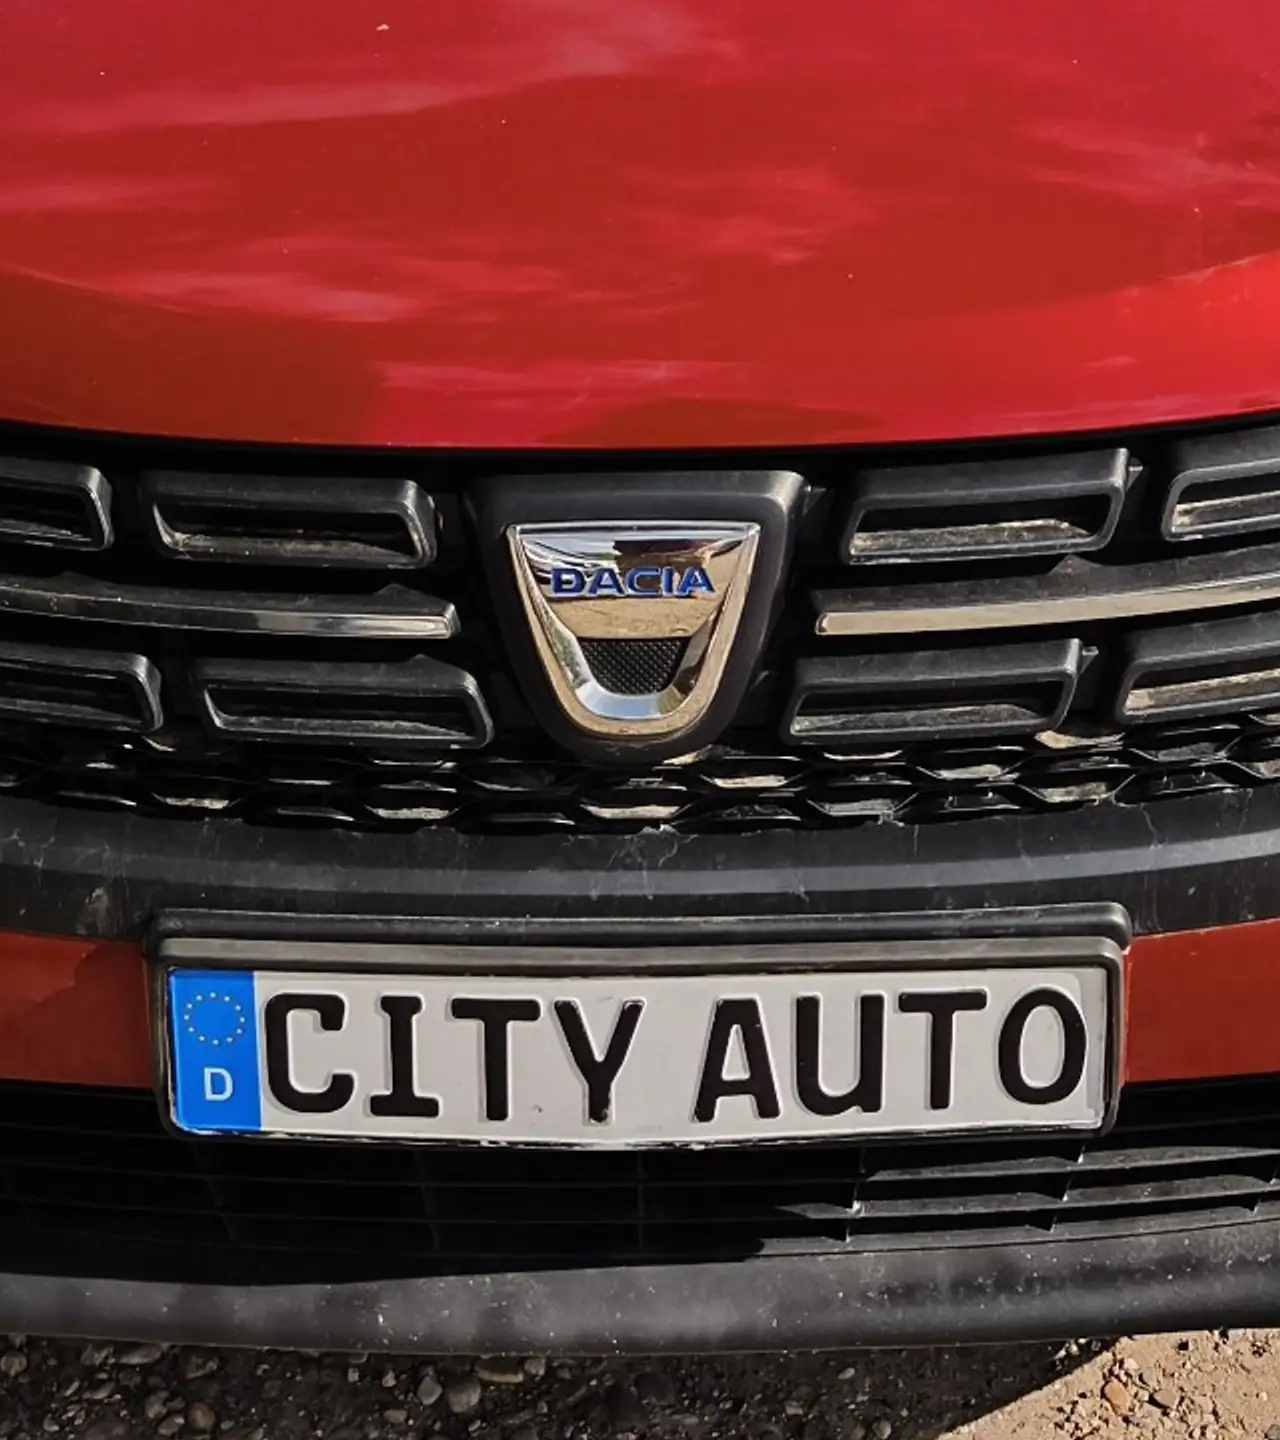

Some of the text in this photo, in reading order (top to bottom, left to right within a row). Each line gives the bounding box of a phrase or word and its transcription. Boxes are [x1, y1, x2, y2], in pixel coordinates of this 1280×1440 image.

[550, 567, 715, 597] DACIA
[203, 987, 1088, 1124] D CITY AUTO
